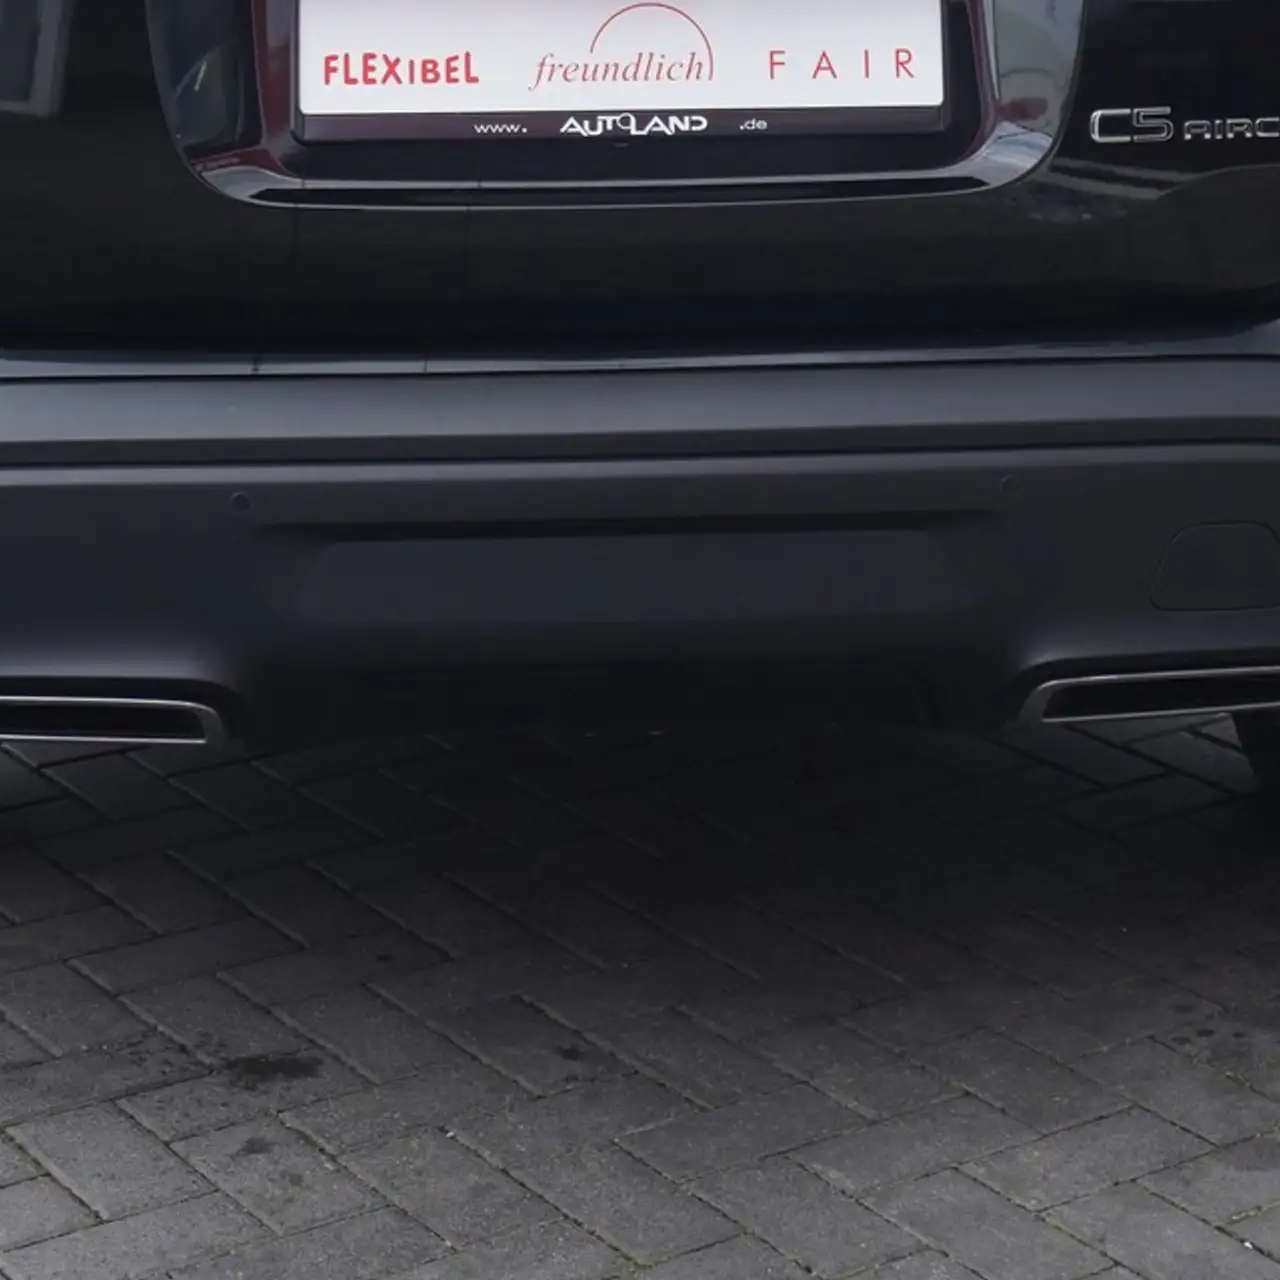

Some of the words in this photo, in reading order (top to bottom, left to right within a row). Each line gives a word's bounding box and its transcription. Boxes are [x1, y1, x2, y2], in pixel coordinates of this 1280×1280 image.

[324, 51, 480, 86] FLEXIBEL
[528, 51, 703, 91] freundlich
[474, 123, 528, 134] www.
[560, 112, 708, 137] AUTOLAND
[739, 118, 768, 131] .de
[1089, 106, 1174, 143] C5
